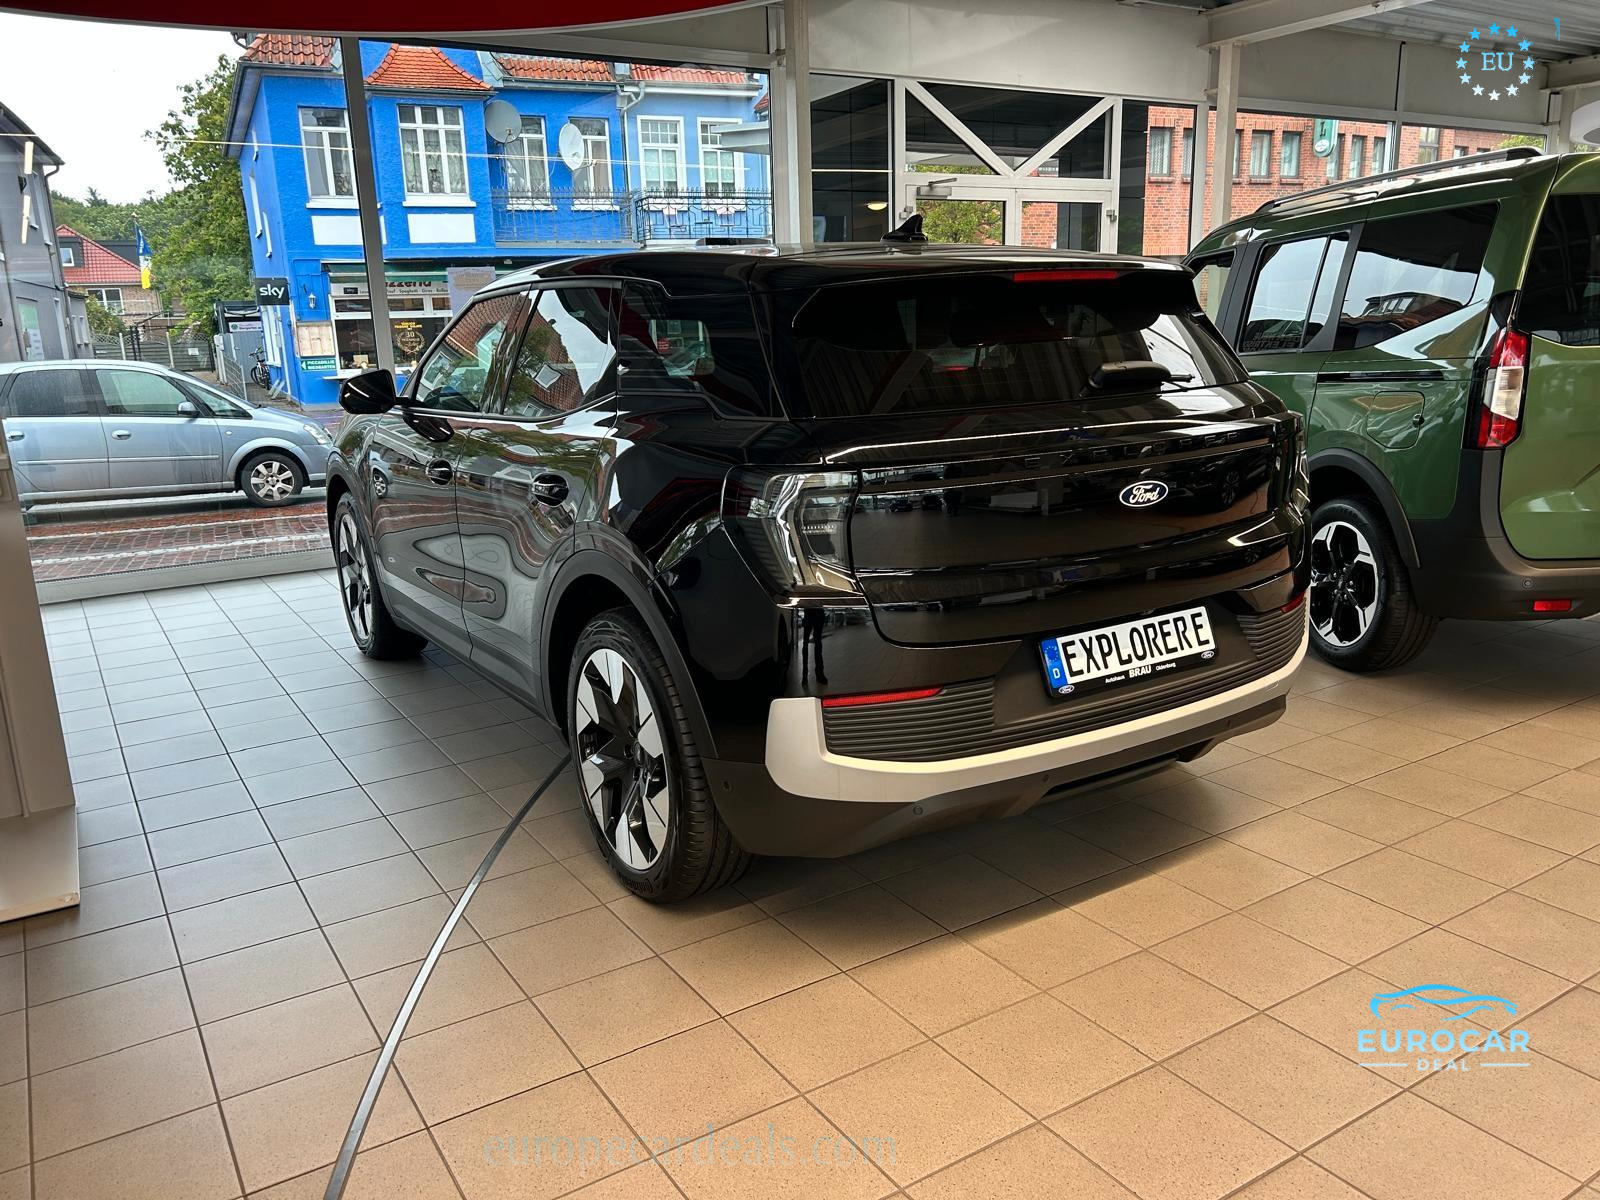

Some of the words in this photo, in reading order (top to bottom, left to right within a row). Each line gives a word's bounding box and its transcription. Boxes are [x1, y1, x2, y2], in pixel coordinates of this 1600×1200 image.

[259, 283, 285, 299] sky
[1128, 484, 1161, 504] Ford
[1061, 616, 1193, 677] EXPLORER
[1190, 612, 1210, 647] E
[1052, 667, 1061, 679] D
[1128, 664, 1152, 678] BRAU
